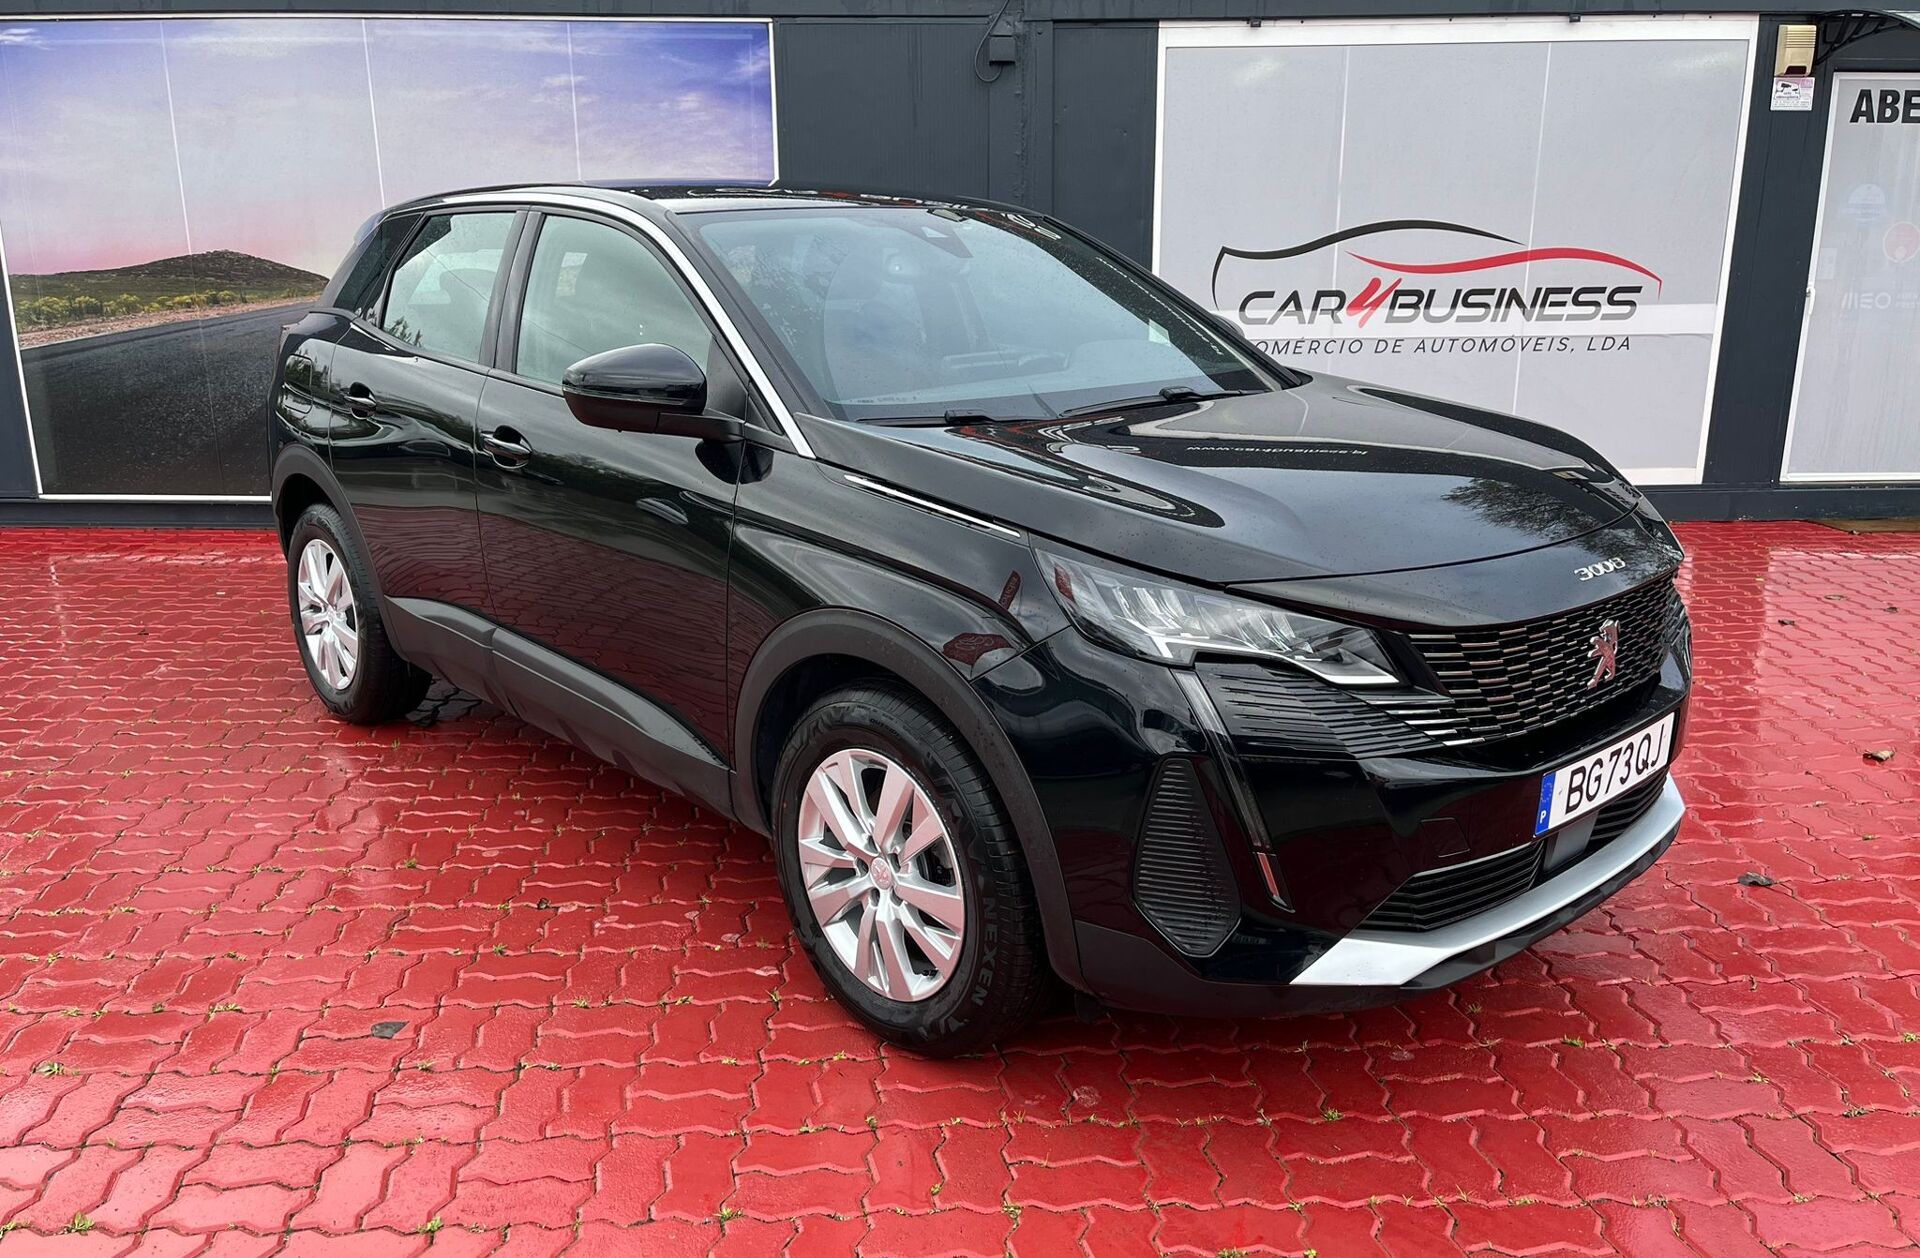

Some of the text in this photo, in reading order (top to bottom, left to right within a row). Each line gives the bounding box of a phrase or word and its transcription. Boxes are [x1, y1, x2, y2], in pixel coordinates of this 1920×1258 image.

[1255, 335, 1631, 355] OMÉRCIO DE AUTOMÓVEIS, LDA
[1574, 557, 1626, 581] 3008
[1539, 810, 1547, 824] P
[971, 896, 998, 1007] NEXEN
